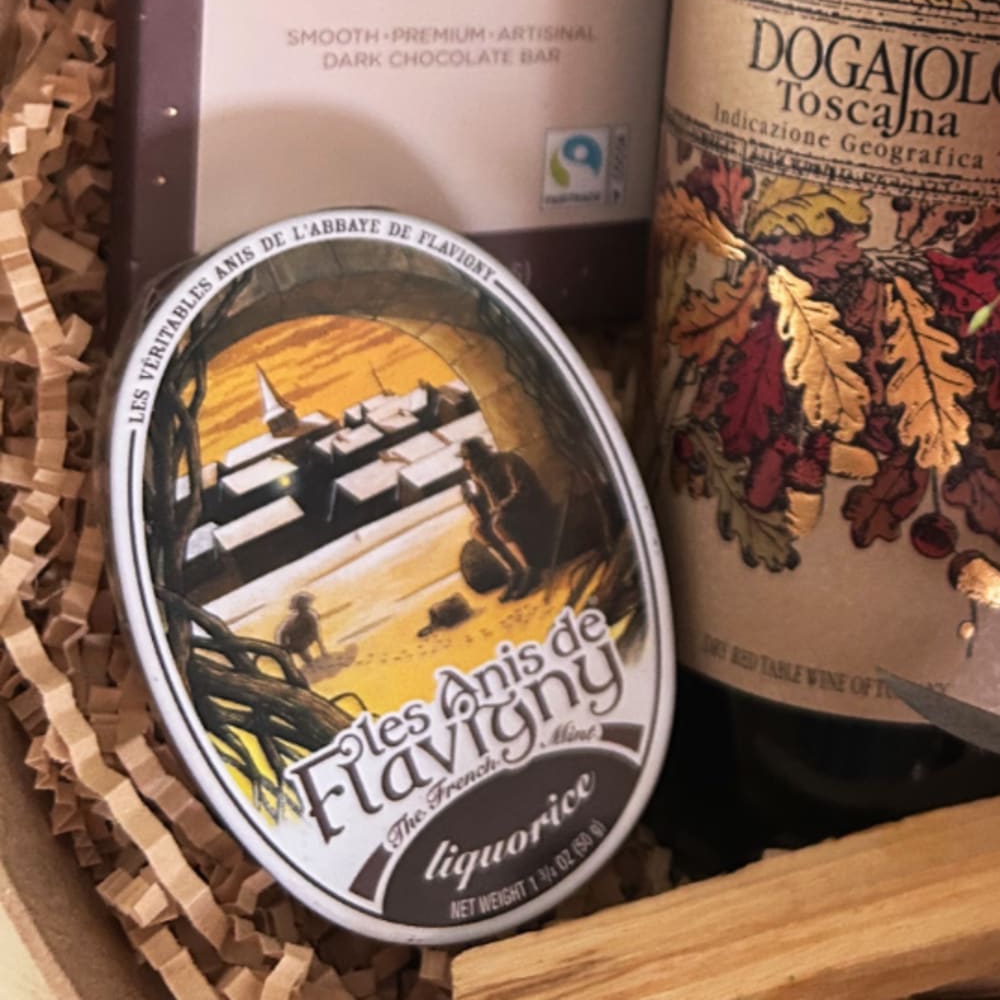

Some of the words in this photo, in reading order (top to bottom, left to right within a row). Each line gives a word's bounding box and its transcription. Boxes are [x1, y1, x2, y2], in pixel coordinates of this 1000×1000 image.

[322, 50, 382, 70] DARK
[389, 48, 512, 69] CHOCOLATE
[521, 47, 561, 65] BAR
[713, 102, 831, 148] Indicazione
[841, 132, 984, 170] Geografica
[129, 388, 151, 425] LES
[215, 246, 257, 281] ANIS
[260, 231, 287, 253] DE
[293, 217, 382, 242] L'ABBAYE
[388, 221, 413, 240] DE
[417, 231, 497, 283] FLAVIGNY
[357, 703, 431, 757] les
[441, 643, 545, 720] Anis
[551, 607, 608, 659] de
[703, 634, 727, 660] DRY
[731, 645, 758, 672] RED
[759, 654, 803, 685] TABLE
[804, 666, 849, 693] WINE
[849, 674, 873, 698] OF
[290, 643, 625, 846] Flavigny
[387, 811, 425, 848] The
[425, 770, 597, 891] liquorice
[450, 899, 476, 920] NET
[478, 880, 527, 911] WEIGHT
[555, 848, 574, 871] OZ
